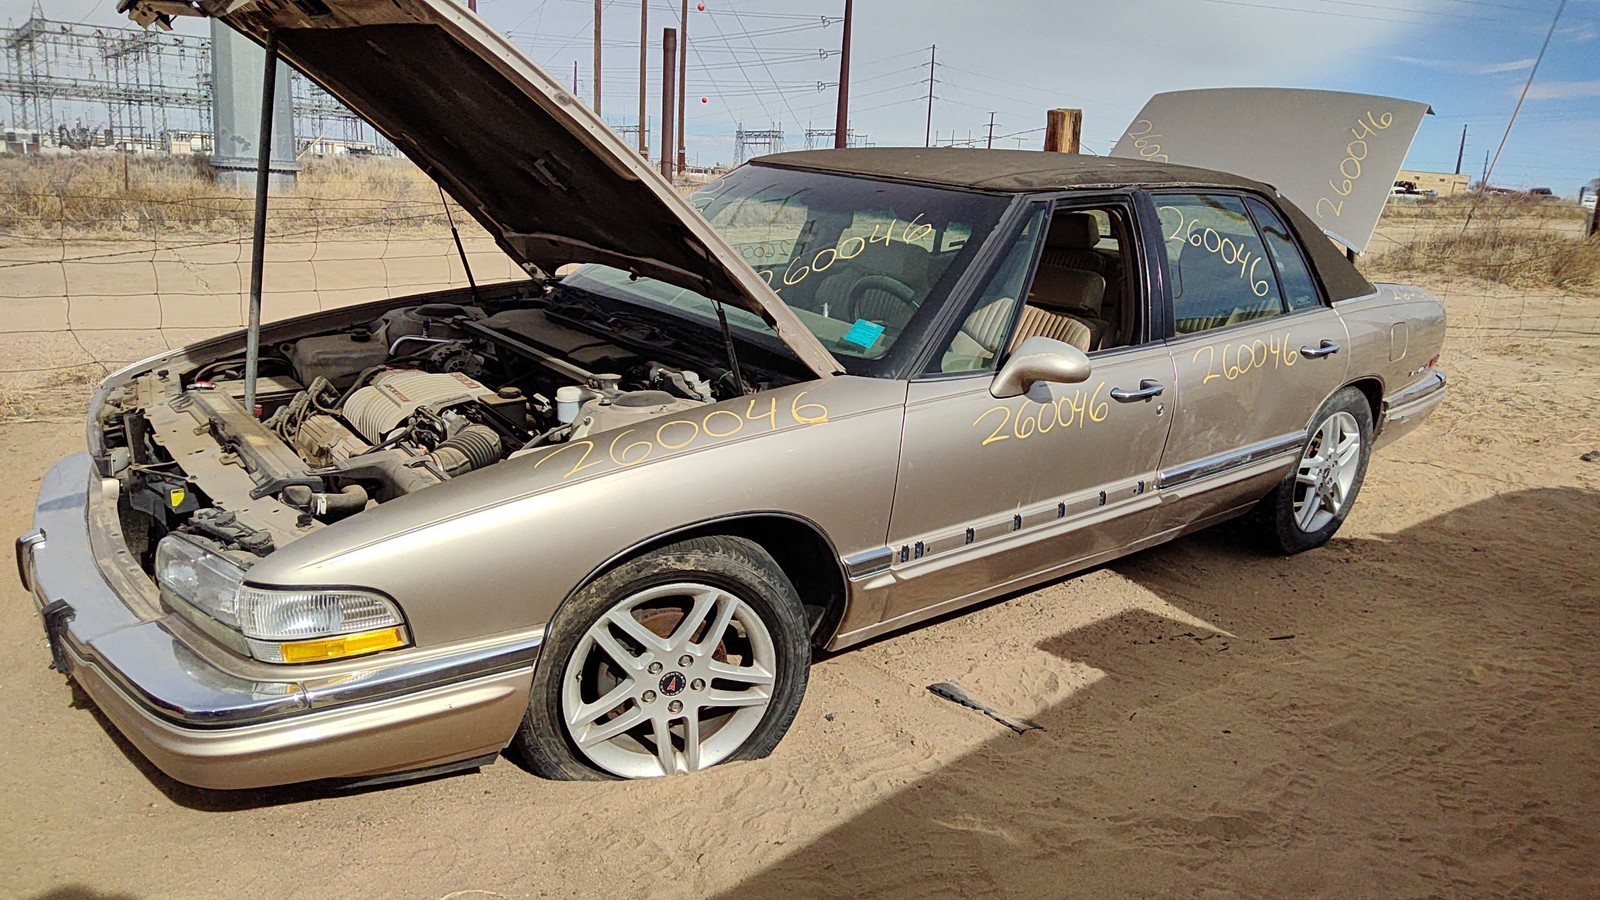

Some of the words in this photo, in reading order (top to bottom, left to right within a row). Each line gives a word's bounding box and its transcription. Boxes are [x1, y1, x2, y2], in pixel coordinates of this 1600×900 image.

[1315, 110, 1393, 218] 260046
[1158, 205, 1270, 297] 260046
[1192, 332, 1298, 385] 260046
[533, 391, 829, 479] 260046
[972, 381, 1109, 446] 260046
